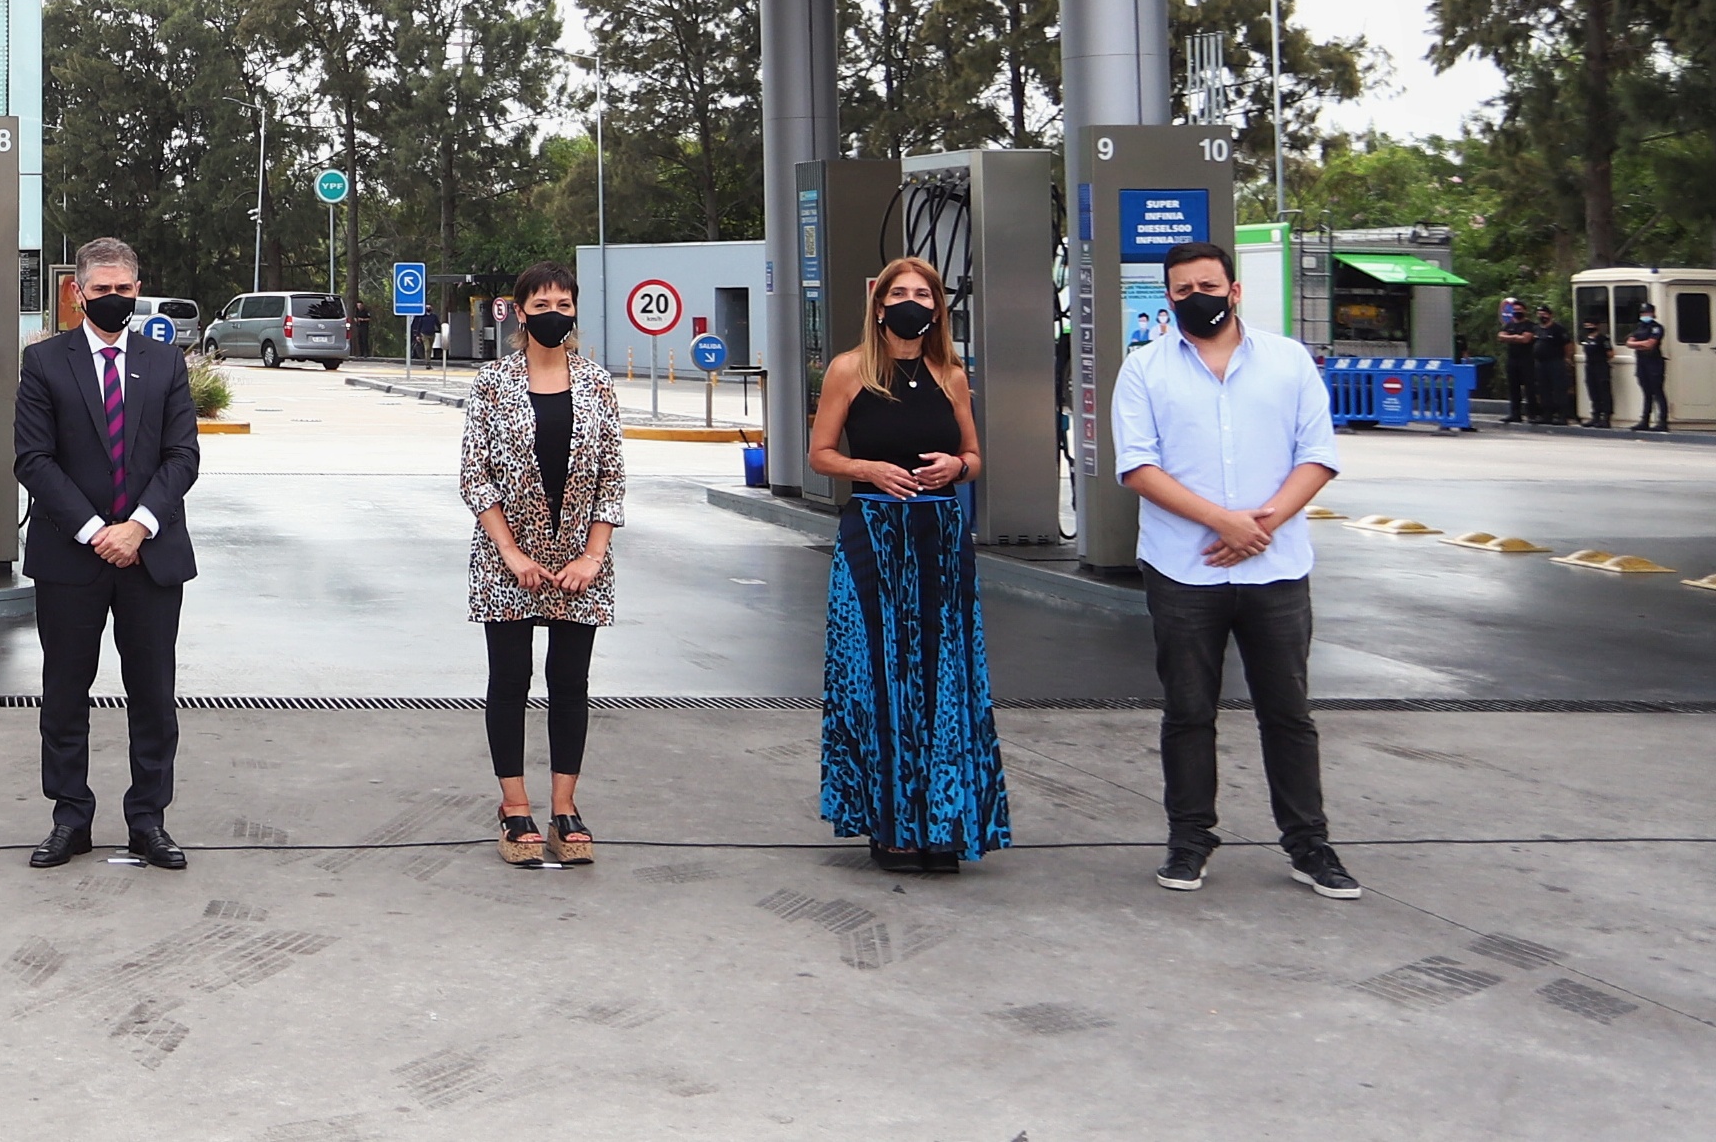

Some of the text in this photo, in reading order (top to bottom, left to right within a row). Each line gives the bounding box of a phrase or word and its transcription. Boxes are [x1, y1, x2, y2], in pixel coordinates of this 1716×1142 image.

[1097, 137, 1114, 160] 9
[1199, 138, 1228, 161] 10
[1146, 200, 1180, 208] SUPER
[1144, 212, 1184, 220] INFINIA
[640, 293, 669, 314] 20
[1210, 310, 1225, 325] YPF
[152, 324, 165, 341] E
